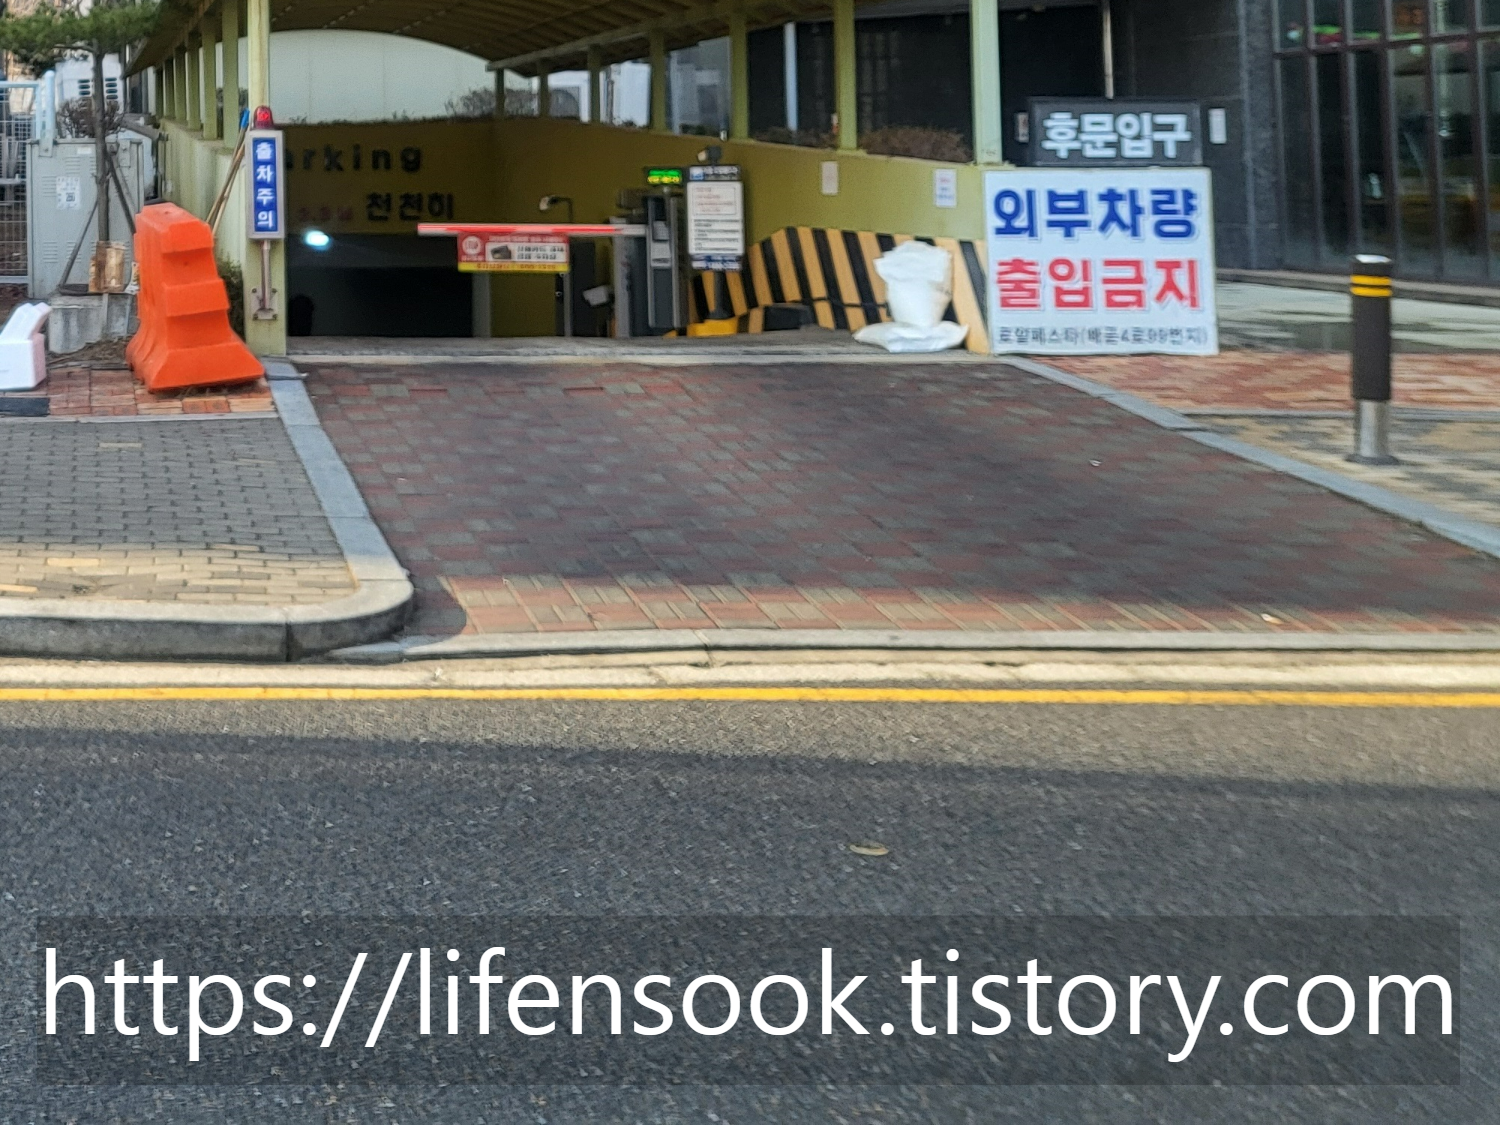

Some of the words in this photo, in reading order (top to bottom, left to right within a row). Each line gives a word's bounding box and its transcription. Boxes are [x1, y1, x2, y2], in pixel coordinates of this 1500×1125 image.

[284, 144, 422, 172] rking
[1041, 112, 1193, 159] 후문입구
[256, 141, 274, 229] 출차주의
[366, 192, 454, 222] 천천히
[993, 188, 1198, 239] 외부차량
[996, 257, 1200, 310] 출입금지
